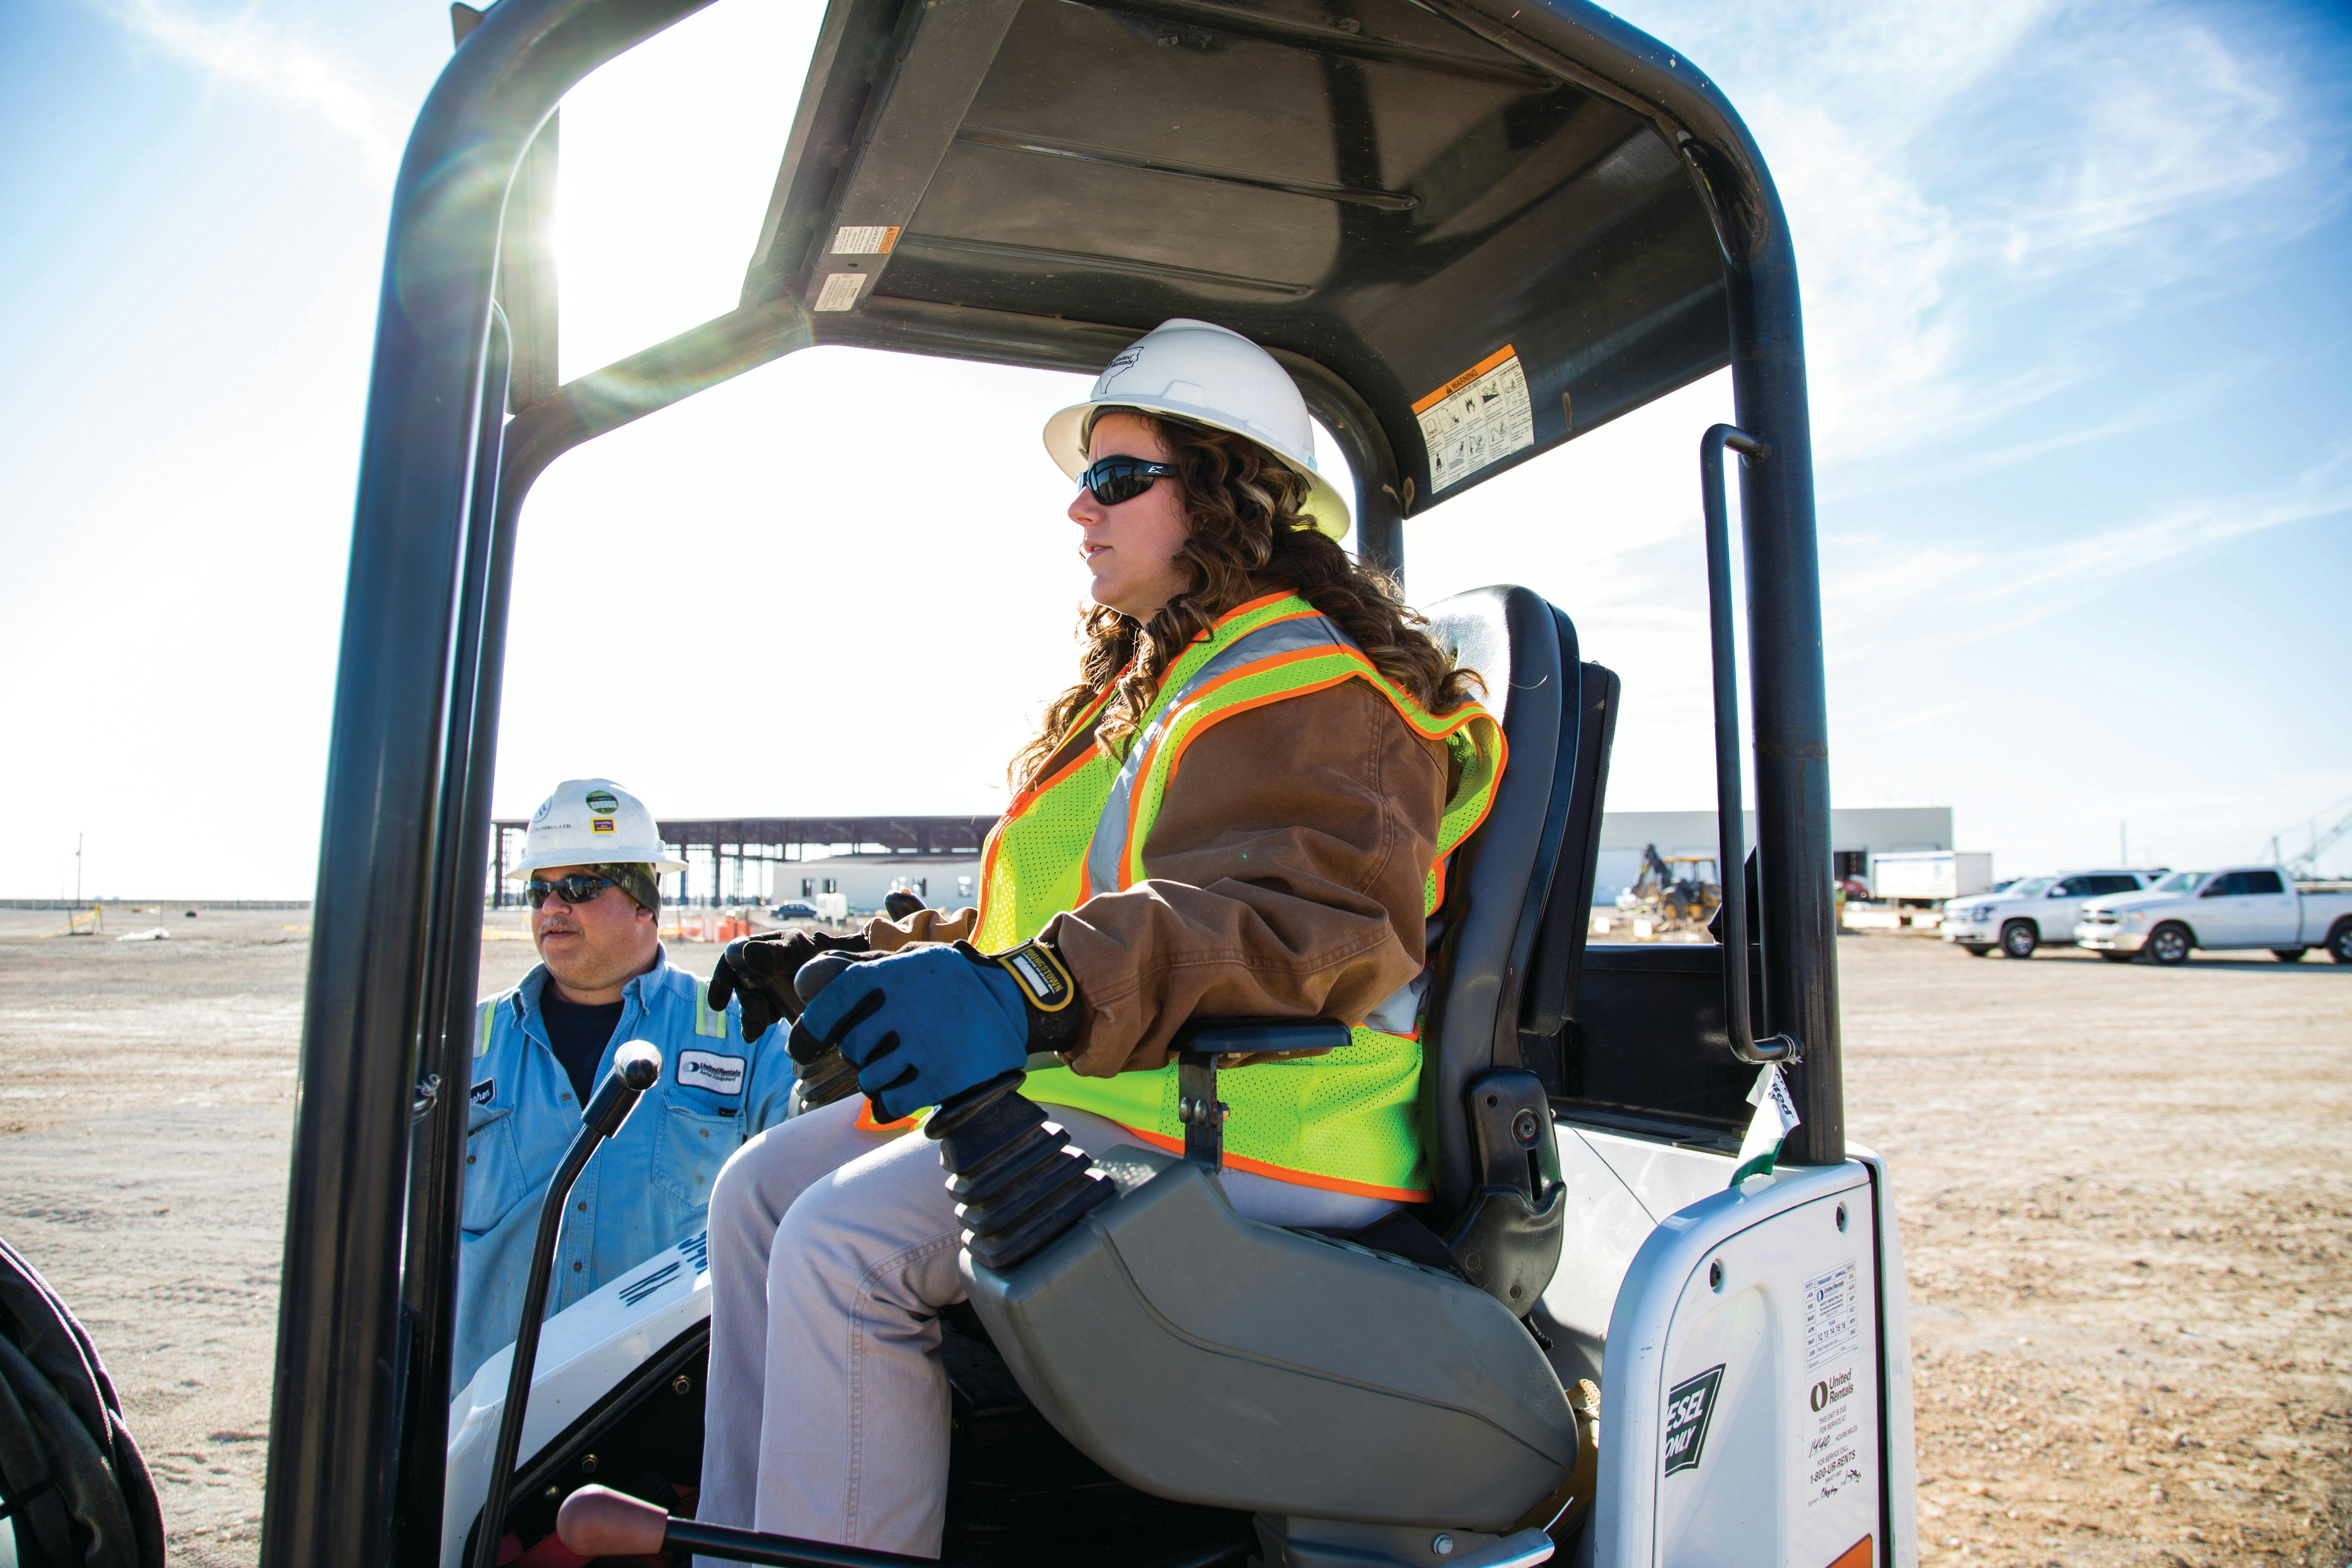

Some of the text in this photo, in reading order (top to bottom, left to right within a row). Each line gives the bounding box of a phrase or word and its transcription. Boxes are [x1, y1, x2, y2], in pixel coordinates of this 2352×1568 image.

[880, 232, 897, 253] WARNING
[1451, 369, 1478, 389] WARNING
[1024, 948, 1063, 992] YOUNGSTOWN
[1817, 1275, 1832, 1286] FREQUENT
[1818, 1321, 1846, 1341] 12 13 14 15 16
[1829, 1367, 1852, 1390] United
[1829, 1382, 1853, 1404] Rentals
[1666, 1387, 1706, 1433] ESEL
[1827, 1410, 1835, 1421] UNIT
[1827, 1417, 1841, 1430] SERVICE
[1841, 1414, 1847, 1423] AT
[1665, 1425, 1697, 1460] ONLY
[1809, 1435, 1831, 1458] 1440
[1825, 1449, 1840, 1462] SERVICE
[1840, 1444, 1849, 1456] CALL
[1810, 1449, 1856, 1485] 1-800-UR-RENTS
